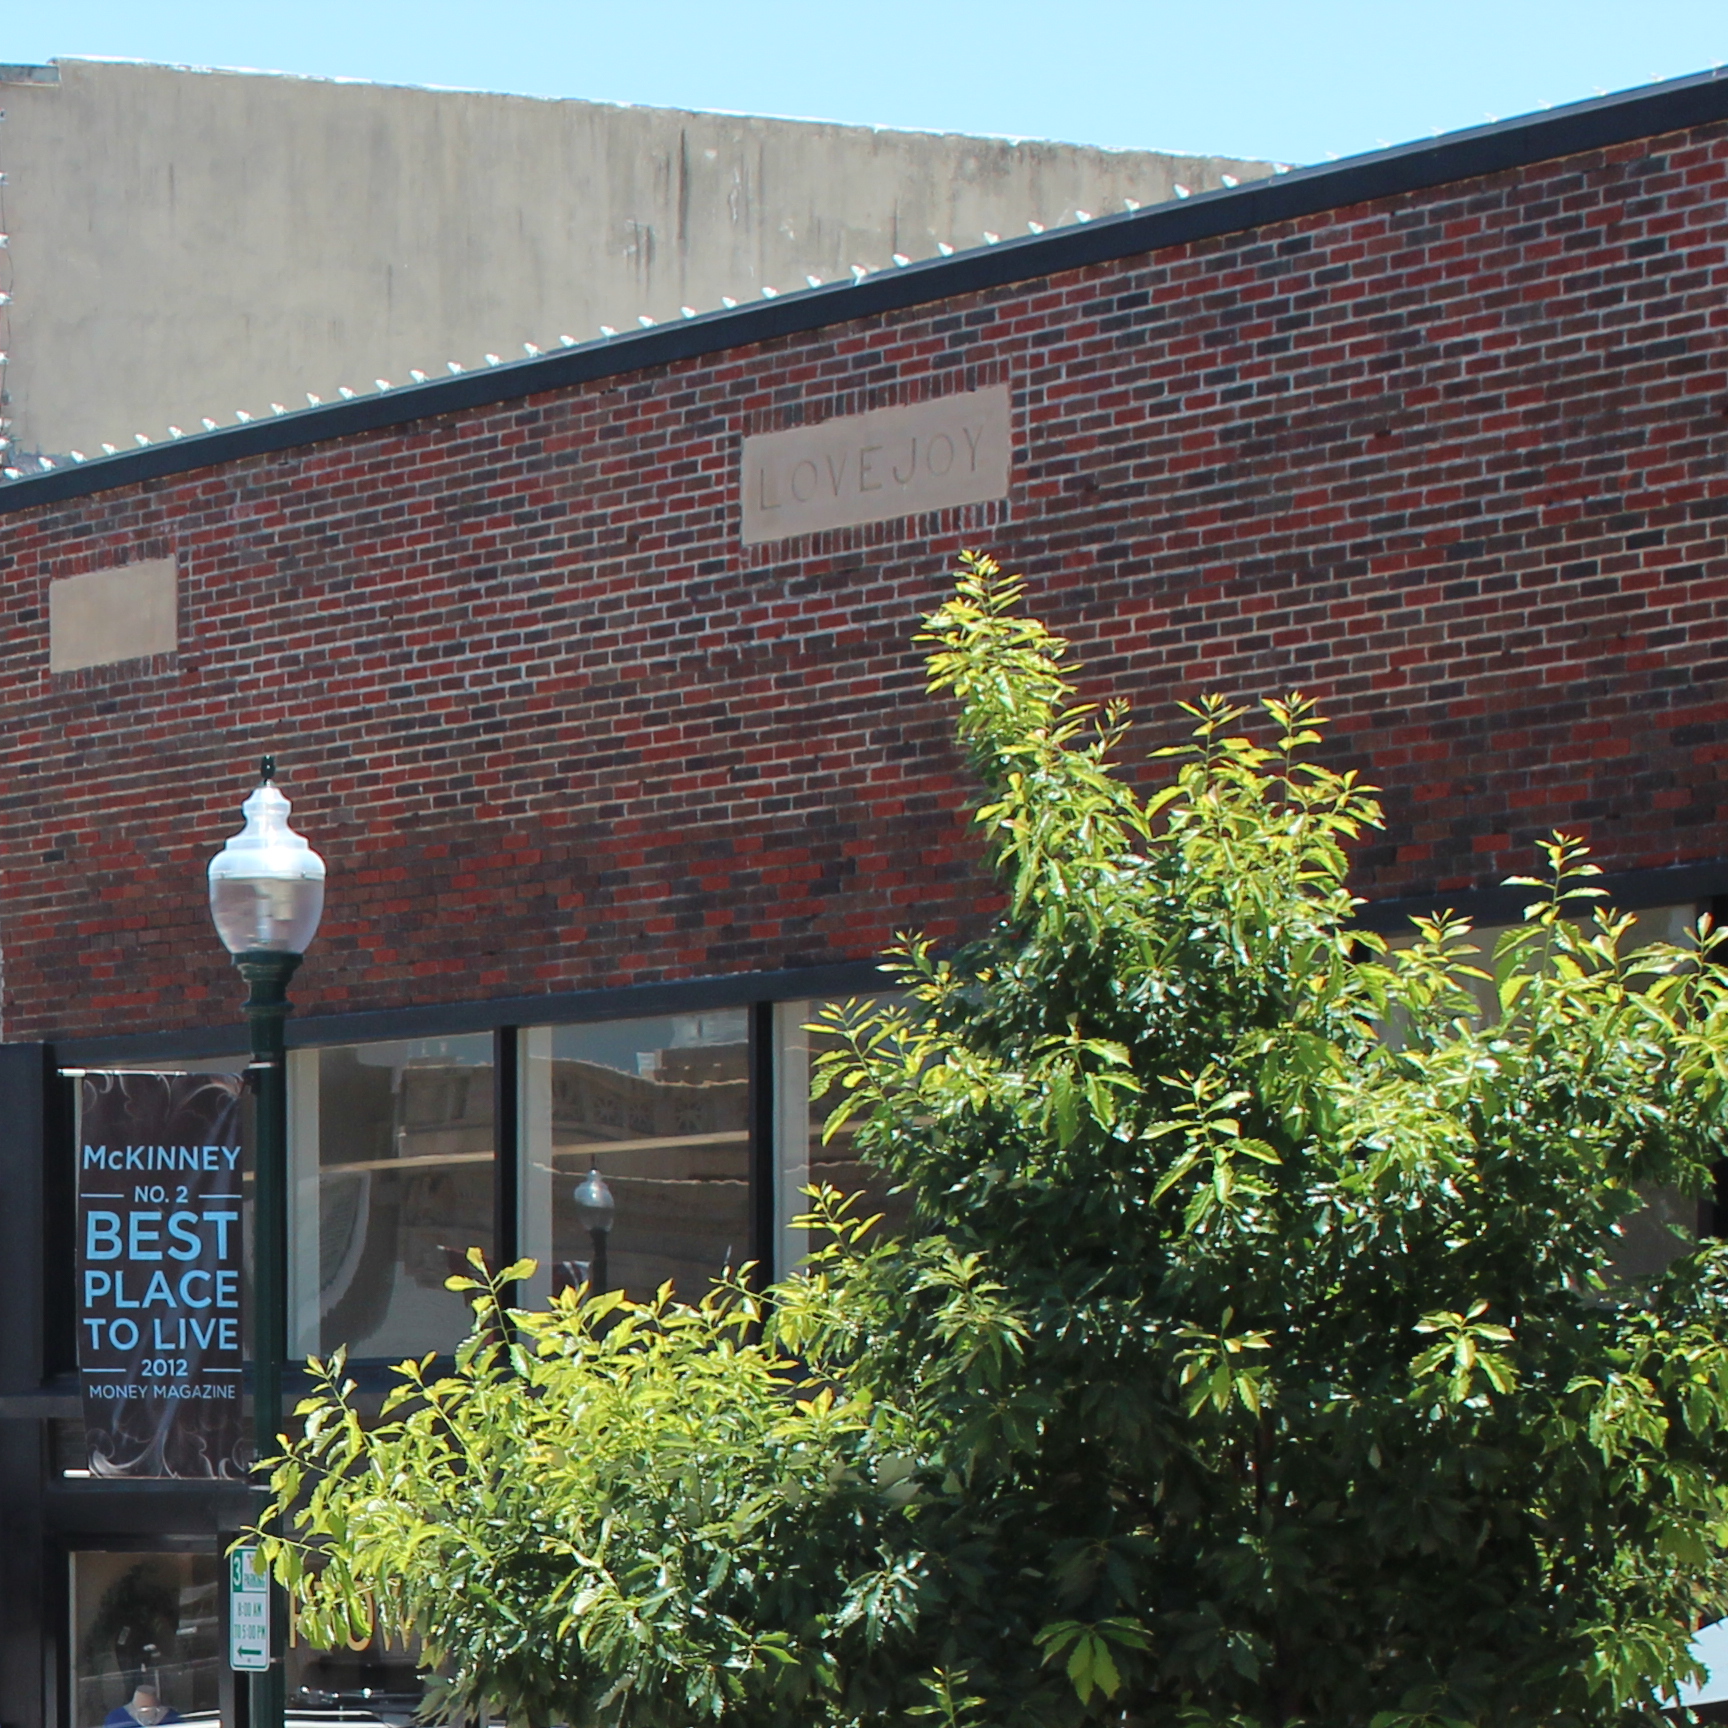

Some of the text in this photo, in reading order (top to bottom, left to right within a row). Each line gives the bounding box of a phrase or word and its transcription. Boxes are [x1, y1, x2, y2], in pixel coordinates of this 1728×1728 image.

[759, 424, 984, 511] LOVEJOY
[83, 1145, 241, 1171] McKINNEY
[134, 1185, 188, 1203] NO. 2
[86, 1210, 238, 1261] BEST
[84, 1270, 239, 1309] PLACE
[83, 1317, 238, 1350] TO LIVE
[141, 1358, 188, 1377] 2012
[89, 1384, 235, 1399] MONEY MAGAZINE
[233, 1556, 242, 1586] 3
